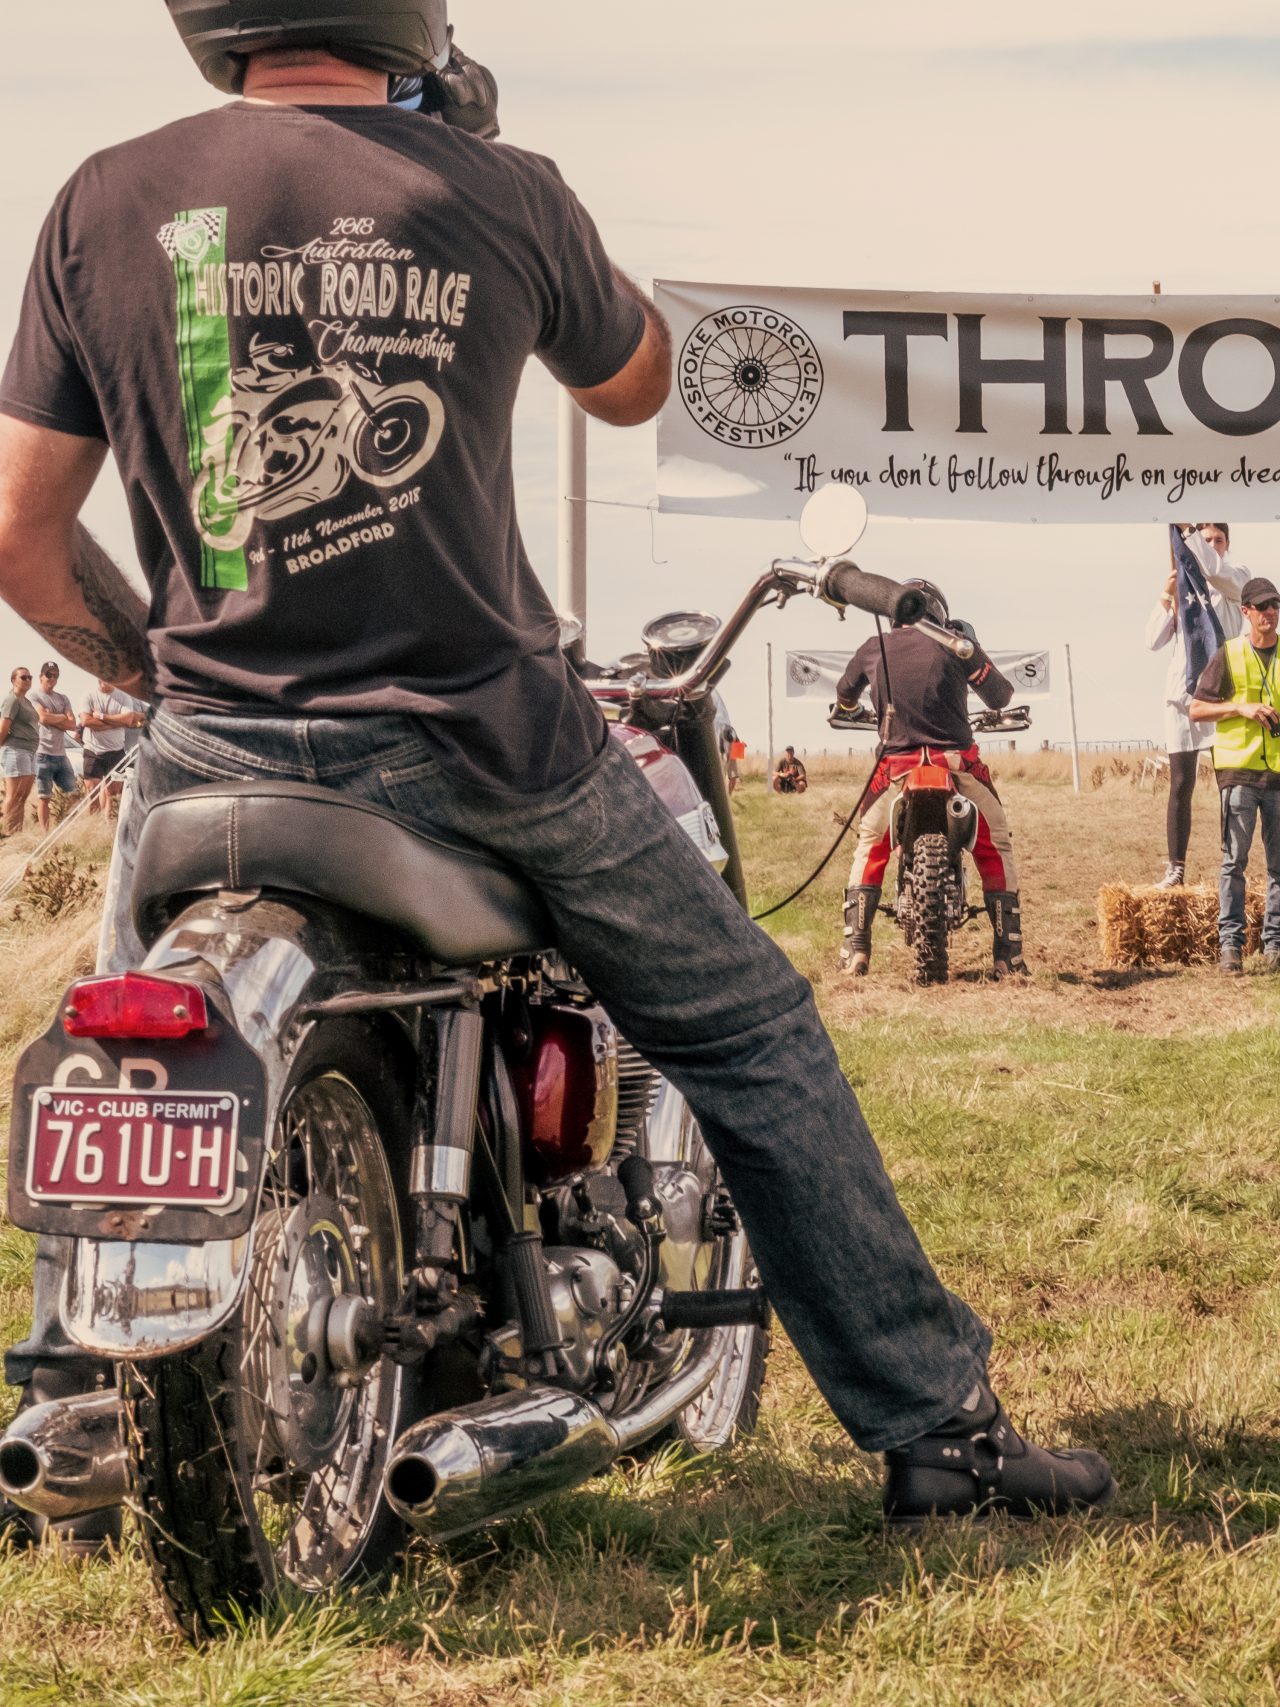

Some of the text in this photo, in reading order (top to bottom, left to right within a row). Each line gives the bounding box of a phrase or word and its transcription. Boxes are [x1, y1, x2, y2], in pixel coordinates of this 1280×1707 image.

[260, 237, 415, 265] Australian
[329, 217, 375, 235] 2018
[193, 261, 471, 327] HISTORIC ROAD RACE
[307, 319, 456, 372] Championships
[683, 310, 819, 405] SPOKE MOTORCYCLE
[701, 411, 805, 444] FESTIVAL
[830, 466, 872, 487] you
[879, 453, 941, 489] don't
[947, 453, 1029, 493] follow
[1036, 452, 1135, 501] through
[1141, 467, 1165, 487] on
[1167, 467, 1223, 504] your
[249, 547, 266, 565] 9th
[282, 528, 313, 552] 11th
[315, 503, 384, 537] November
[388, 486, 422, 513] 2018
[285, 522, 396, 575] BROADFORD
[53, 1100, 84, 1116] VIC
[97, 1101, 148, 1118] CLUB
[152, 1102, 221, 1120] PERMIT
